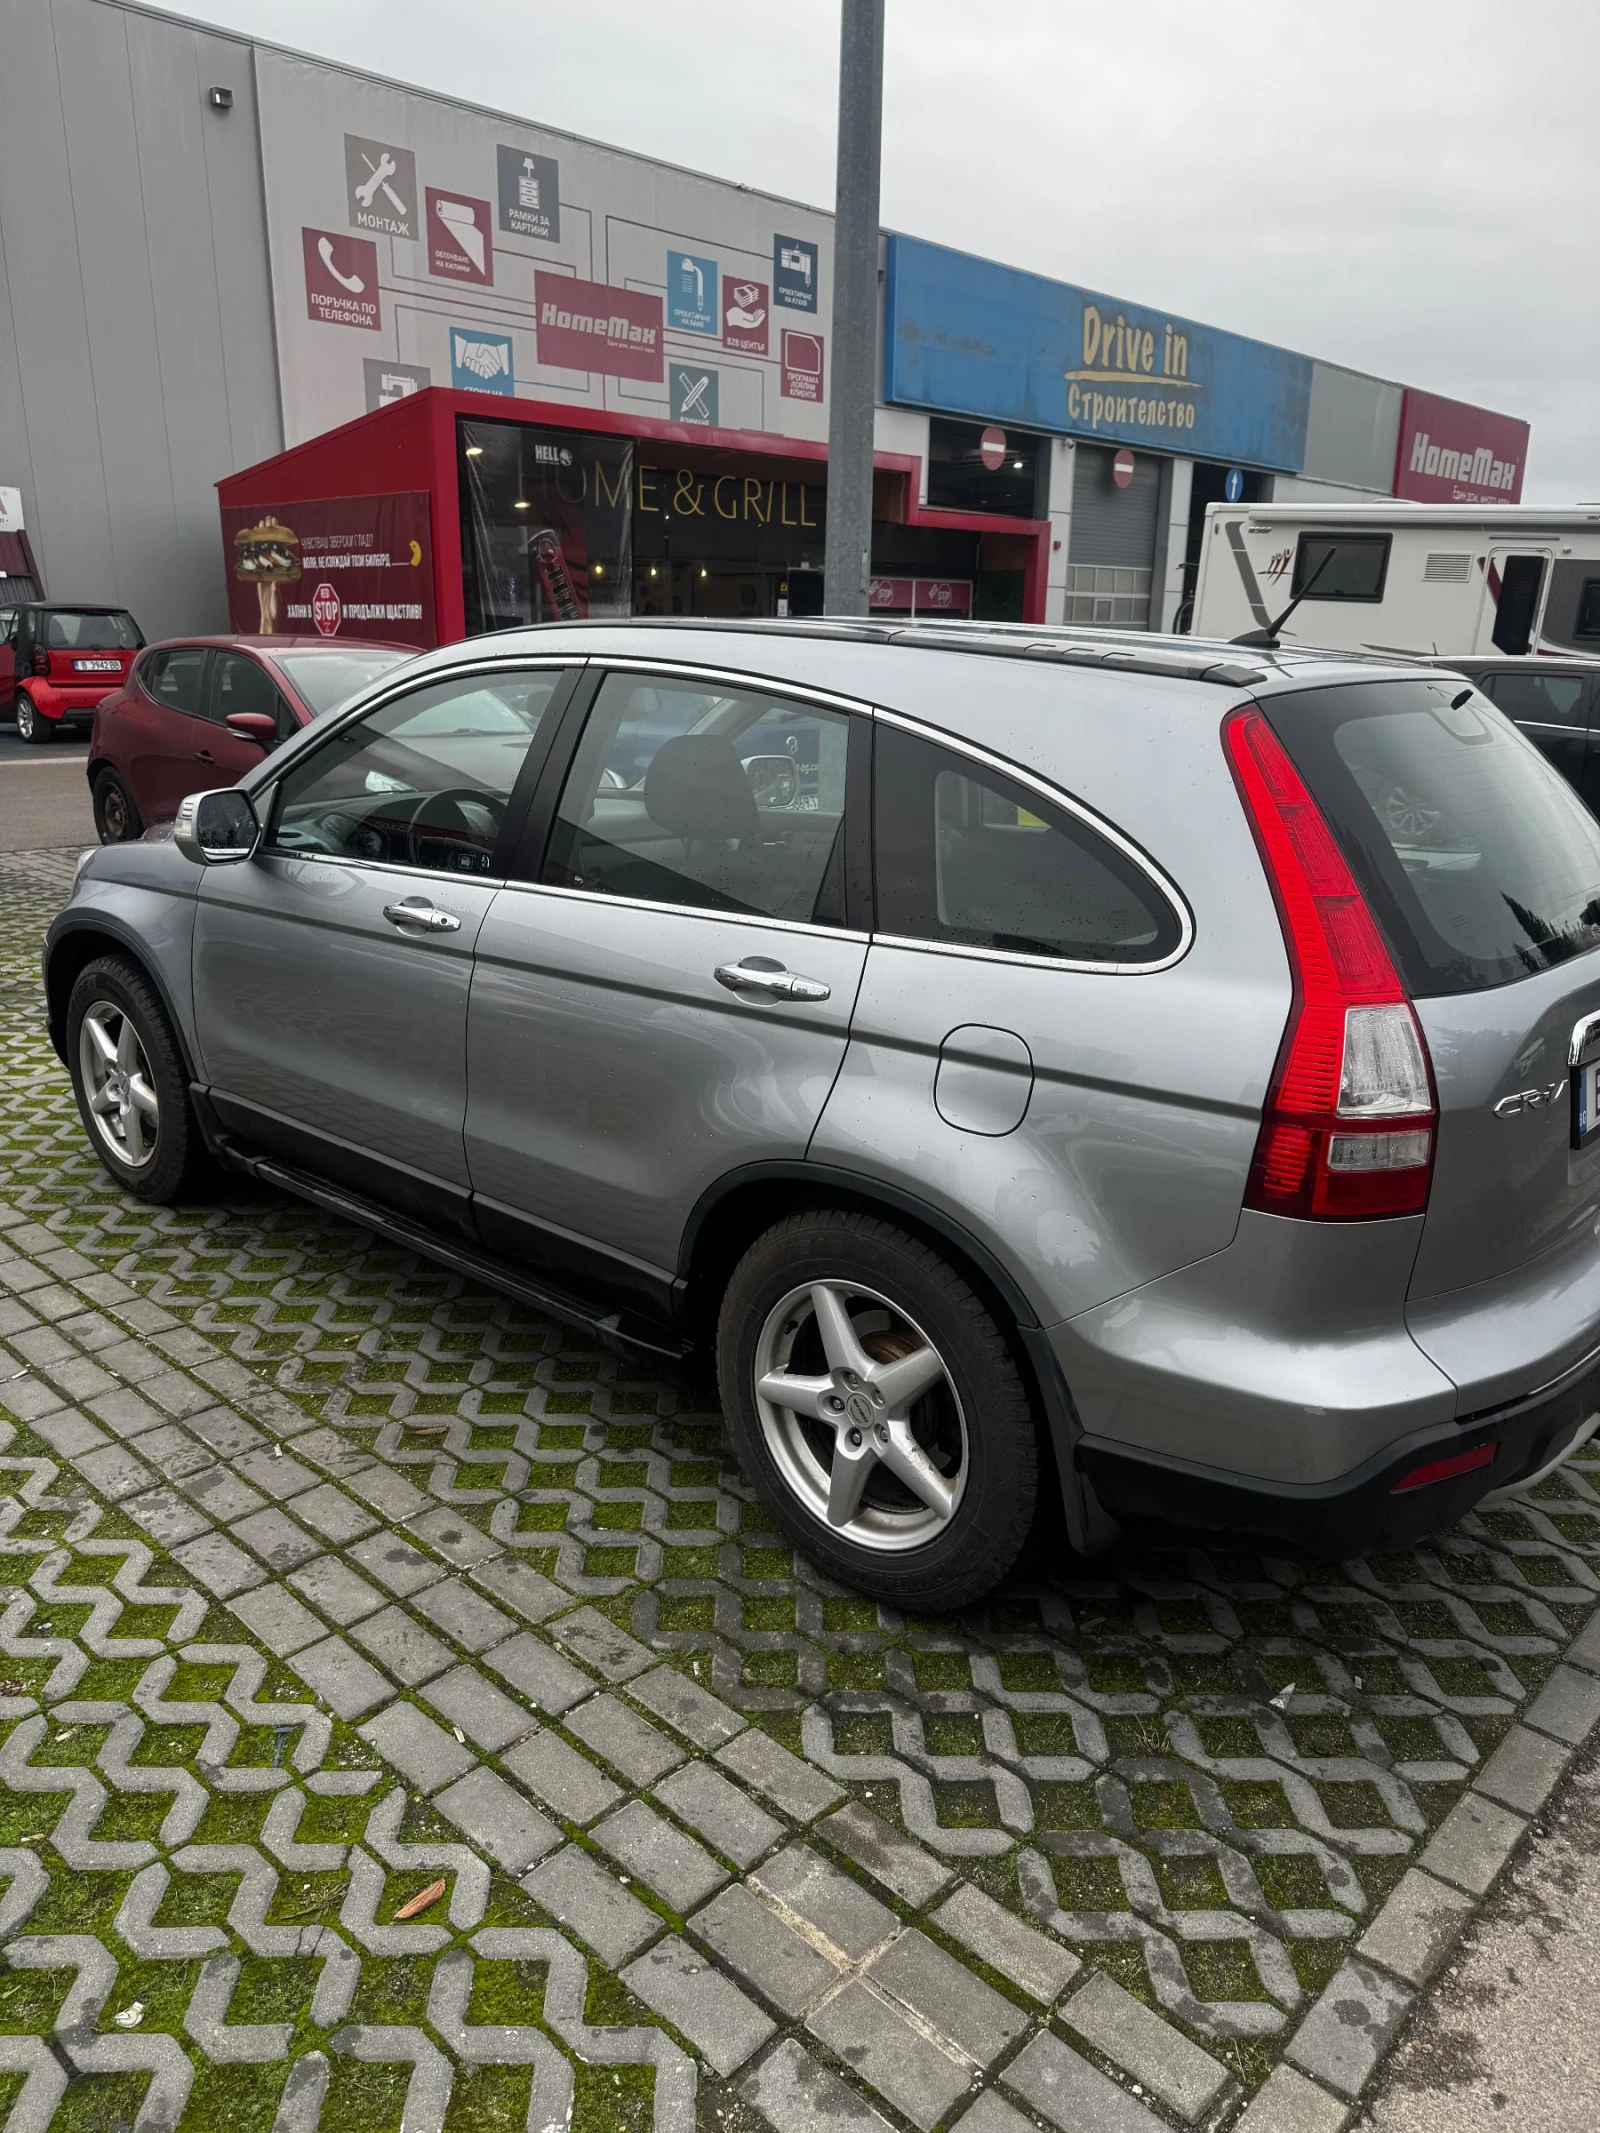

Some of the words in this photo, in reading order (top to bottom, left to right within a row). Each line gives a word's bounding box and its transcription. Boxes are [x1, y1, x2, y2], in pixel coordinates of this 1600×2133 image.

[357, 212, 410, 236] МОНТАЖ
[509, 208, 539, 224] РАМКИ
[539, 215, 550, 226] ЗА
[511, 220, 549, 237] КАРТИНИ
[311, 293, 360, 312] ПОРЪЧКА
[361, 302, 377, 314] ПО
[319, 307, 374, 326] ТЕЛЕФОНА
[541, 302, 657, 345] HomeMax
[1082, 305, 1154, 372] Drive
[1164, 323, 1188, 378] in
[1067, 382, 1196, 430] Строителство
[535, 444, 560, 461] HELL
[1408, 431, 1517, 491] HomeMax
[673, 469, 706, 516] &
[713, 475, 818, 527] GRILL
[315, 601, 338, 621] STOP
[81, 661, 88, 670] B
[1493, 1078, 1568, 1119] CR-V
